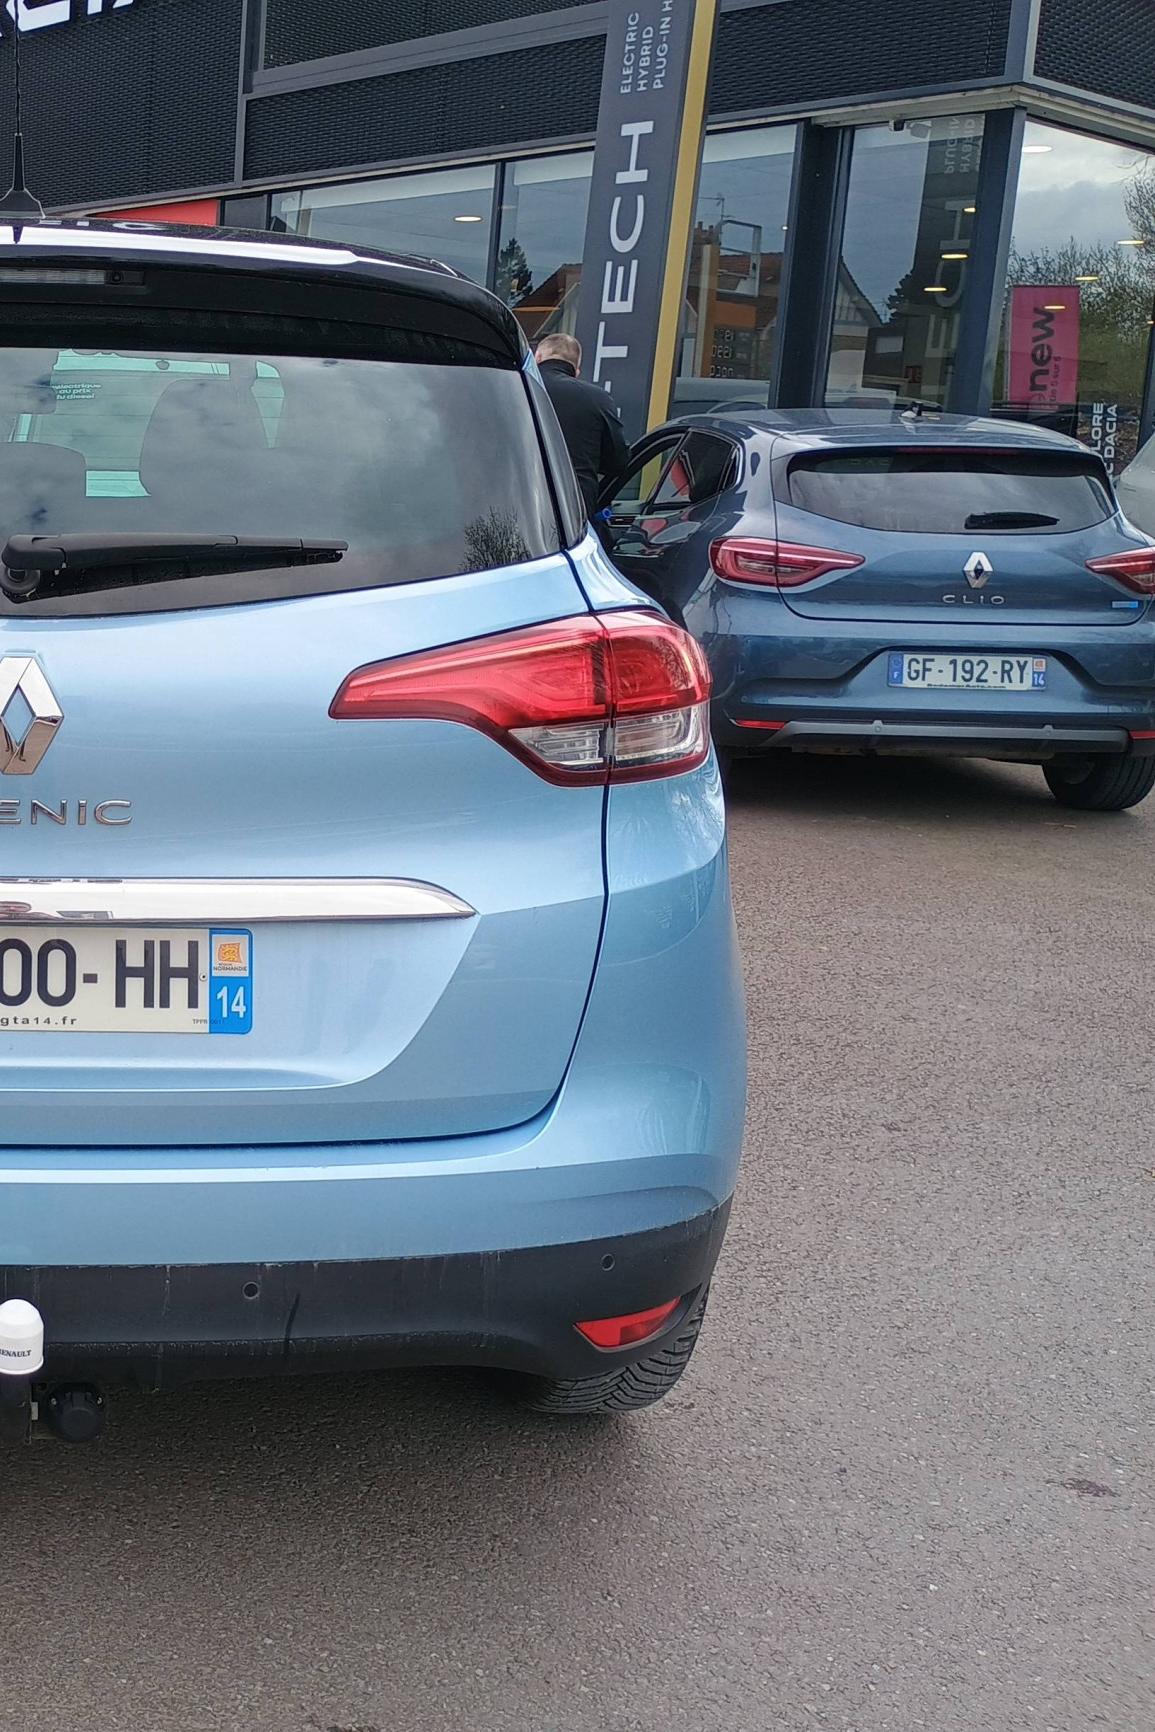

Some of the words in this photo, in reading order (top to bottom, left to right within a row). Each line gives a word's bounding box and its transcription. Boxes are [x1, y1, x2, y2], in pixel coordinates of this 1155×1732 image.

[620, 12, 640, 94] ELECTRIC
[636, 26, 654, 91] HYBRID
[653, 16, 672, 89] PLUG-IN
[1029, 307, 1055, 395] new
[1090, 403, 1104, 451] LORE
[1104, 404, 1118, 458] DACIA
[907, 657, 1029, 684] GF-192-RY
[216, 985, 247, 1018] 14
